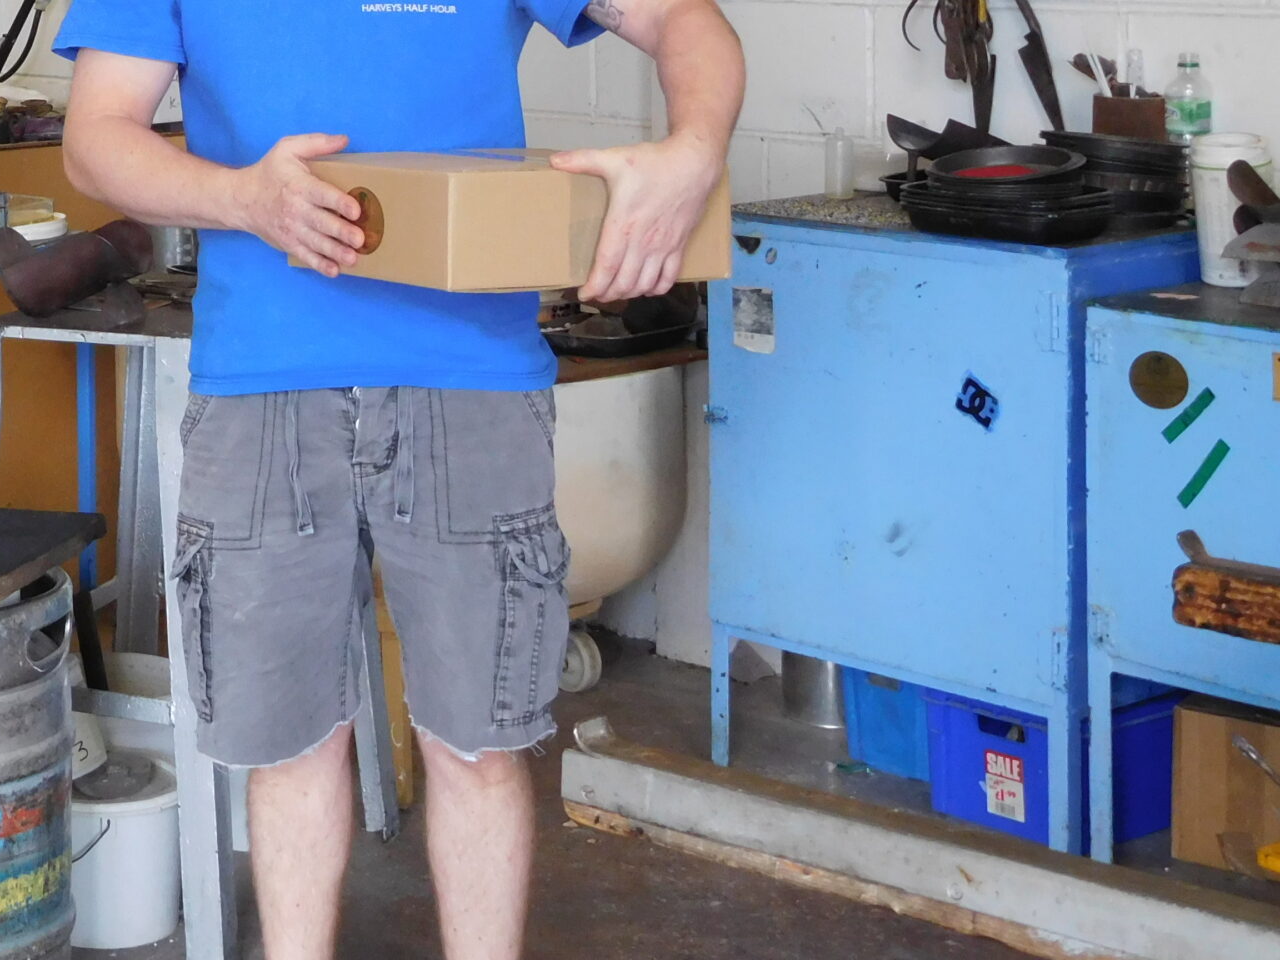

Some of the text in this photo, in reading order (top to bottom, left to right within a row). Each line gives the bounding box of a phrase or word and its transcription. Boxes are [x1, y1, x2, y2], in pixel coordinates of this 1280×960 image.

[362, 3, 456, 14] HARVEYS HALF HOUR
[986, 752, 1021, 781] SALE
